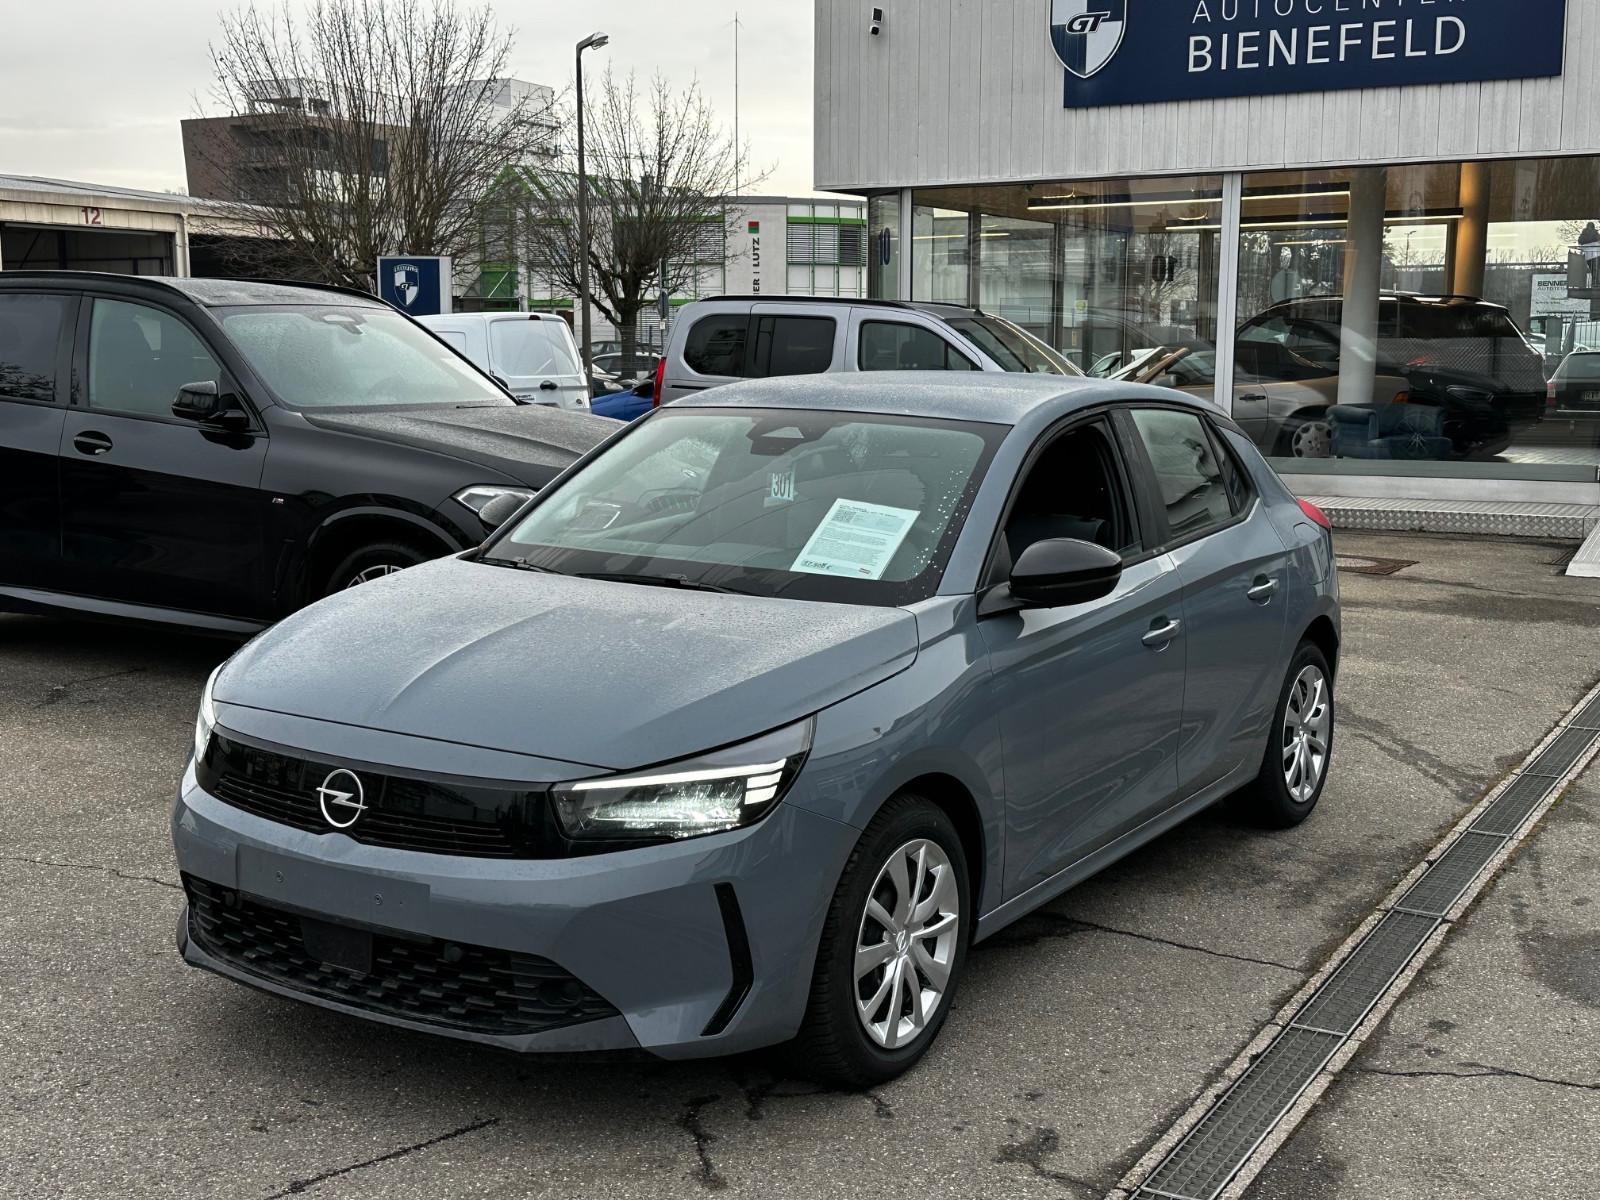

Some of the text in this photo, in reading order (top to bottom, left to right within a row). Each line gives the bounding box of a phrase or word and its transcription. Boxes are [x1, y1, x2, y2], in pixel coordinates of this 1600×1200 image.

[1065, 11, 1111, 34] GT
[1192, 0, 1467, 23] AUTOC
[1188, 16, 1466, 73] BIENEFELD
[81, 206, 101, 225] 12
[752, 237, 760, 267] LUTZ
[773, 472, 792, 498] 301
